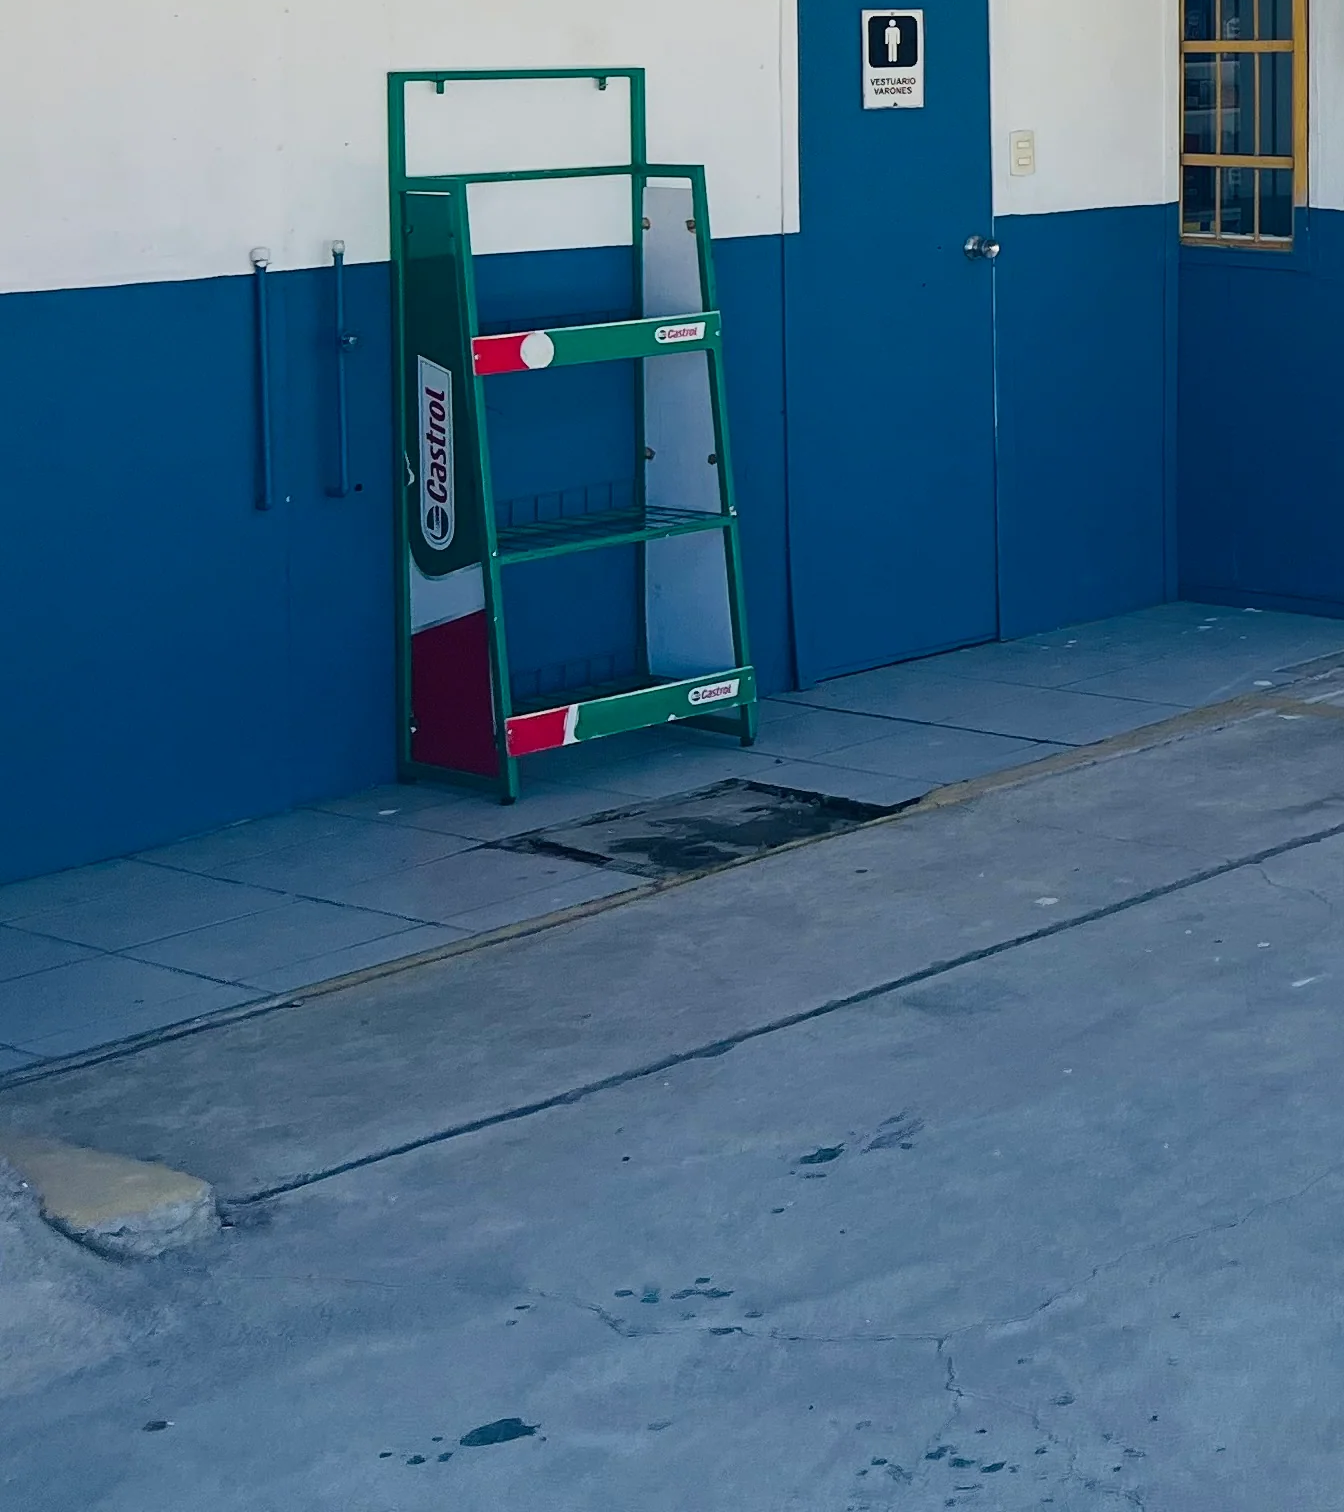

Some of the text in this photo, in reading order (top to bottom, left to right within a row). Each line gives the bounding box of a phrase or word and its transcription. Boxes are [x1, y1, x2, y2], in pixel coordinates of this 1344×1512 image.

[870, 77, 916, 86] VESTUARIO
[874, 86, 912, 95] VARONES
[668, 327, 698, 339] Castrol
[425, 387, 447, 504] Castrol
[702, 684, 731, 699] Castrol
